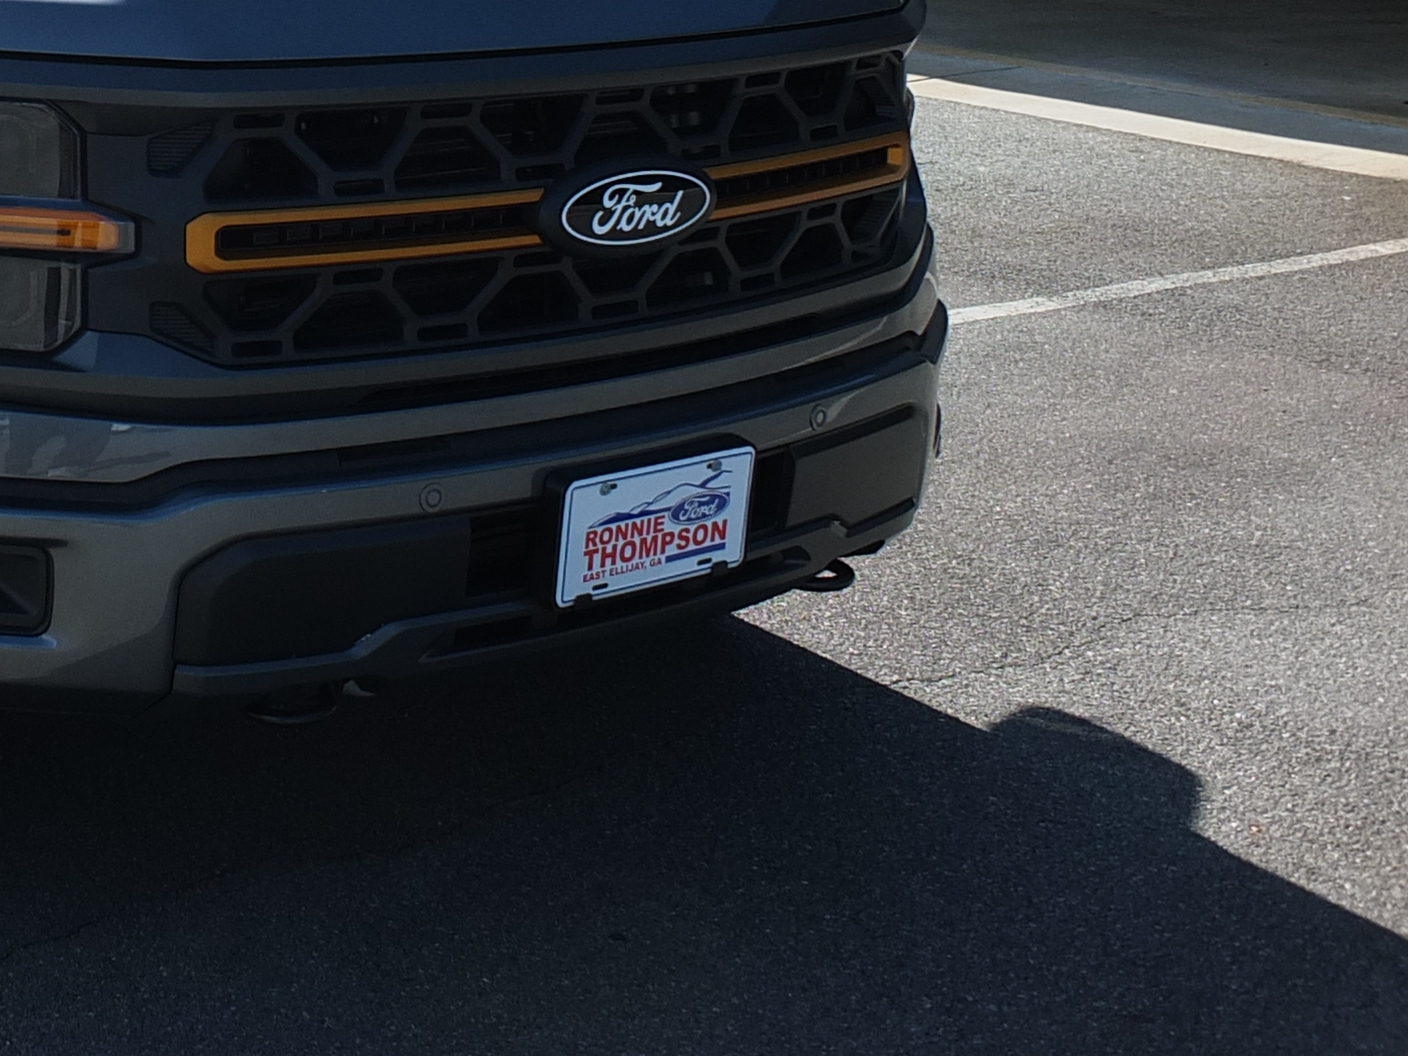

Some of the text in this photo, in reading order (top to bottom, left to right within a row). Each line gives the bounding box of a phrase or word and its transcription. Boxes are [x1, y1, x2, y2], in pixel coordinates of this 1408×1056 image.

[592, 181, 684, 235] Ford
[678, 495, 718, 521] Ford
[583, 518, 728, 572] THOMPSON
[584, 514, 666, 550] RONNIE
[582, 557, 662, 583] EAST ELLIJAY, GA
